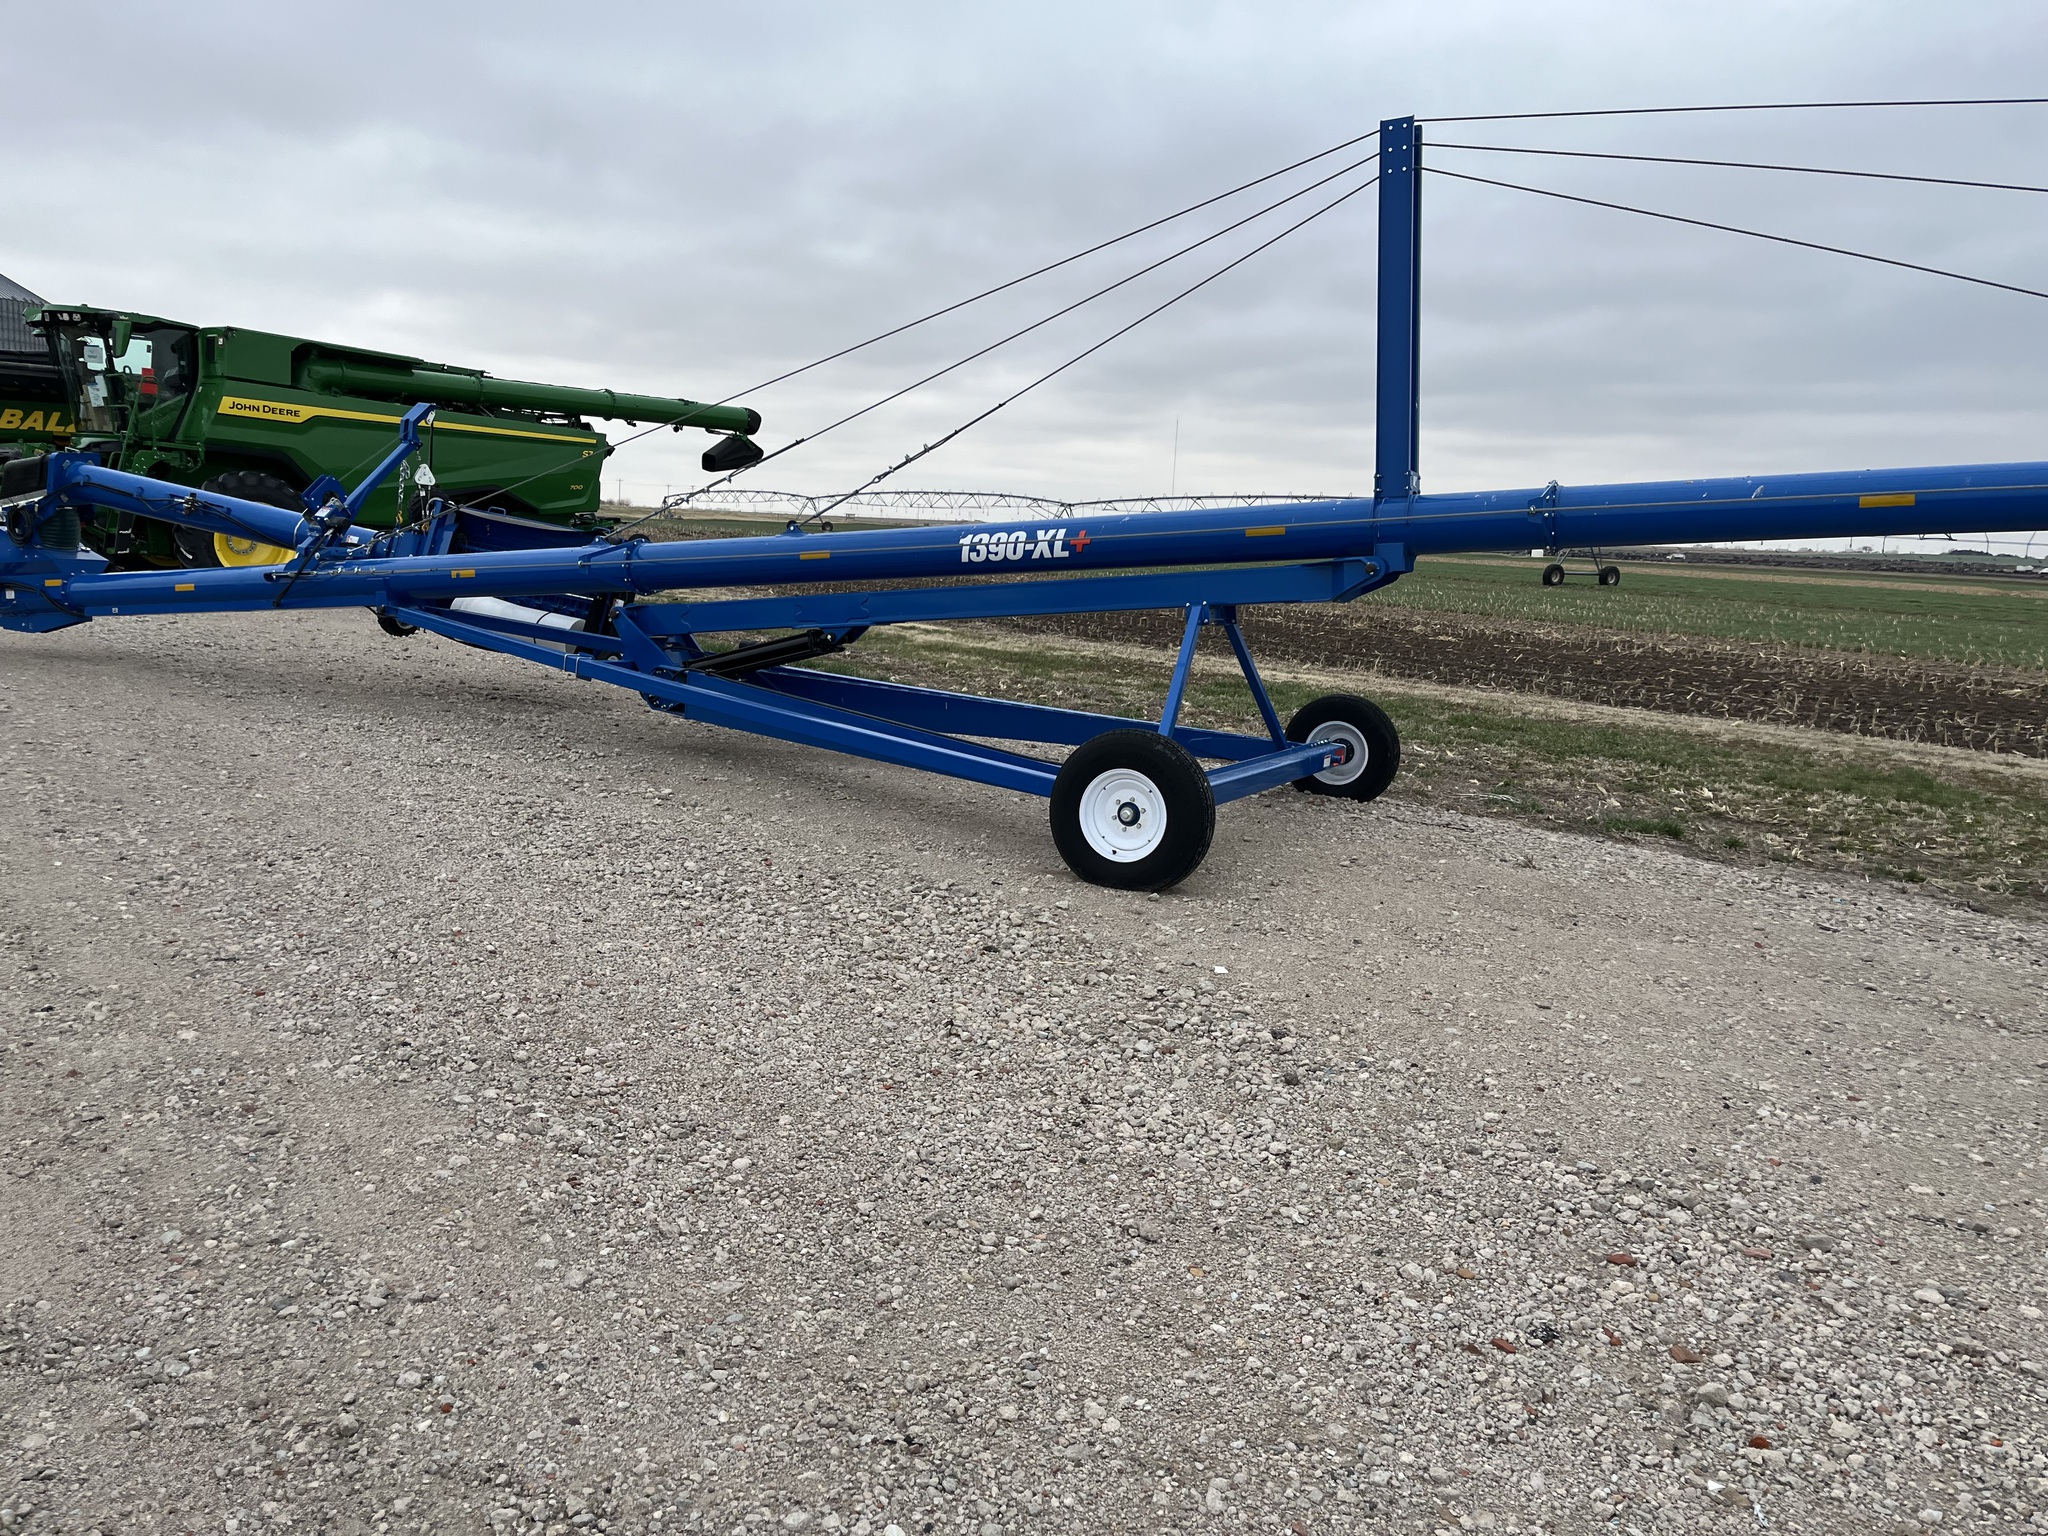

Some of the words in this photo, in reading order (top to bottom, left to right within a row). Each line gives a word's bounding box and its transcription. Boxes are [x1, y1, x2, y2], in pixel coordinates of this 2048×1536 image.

[229, 401, 260, 412] JOHN
[262, 405, 300, 417] DEERE
[0, 408, 76, 433] BAL
